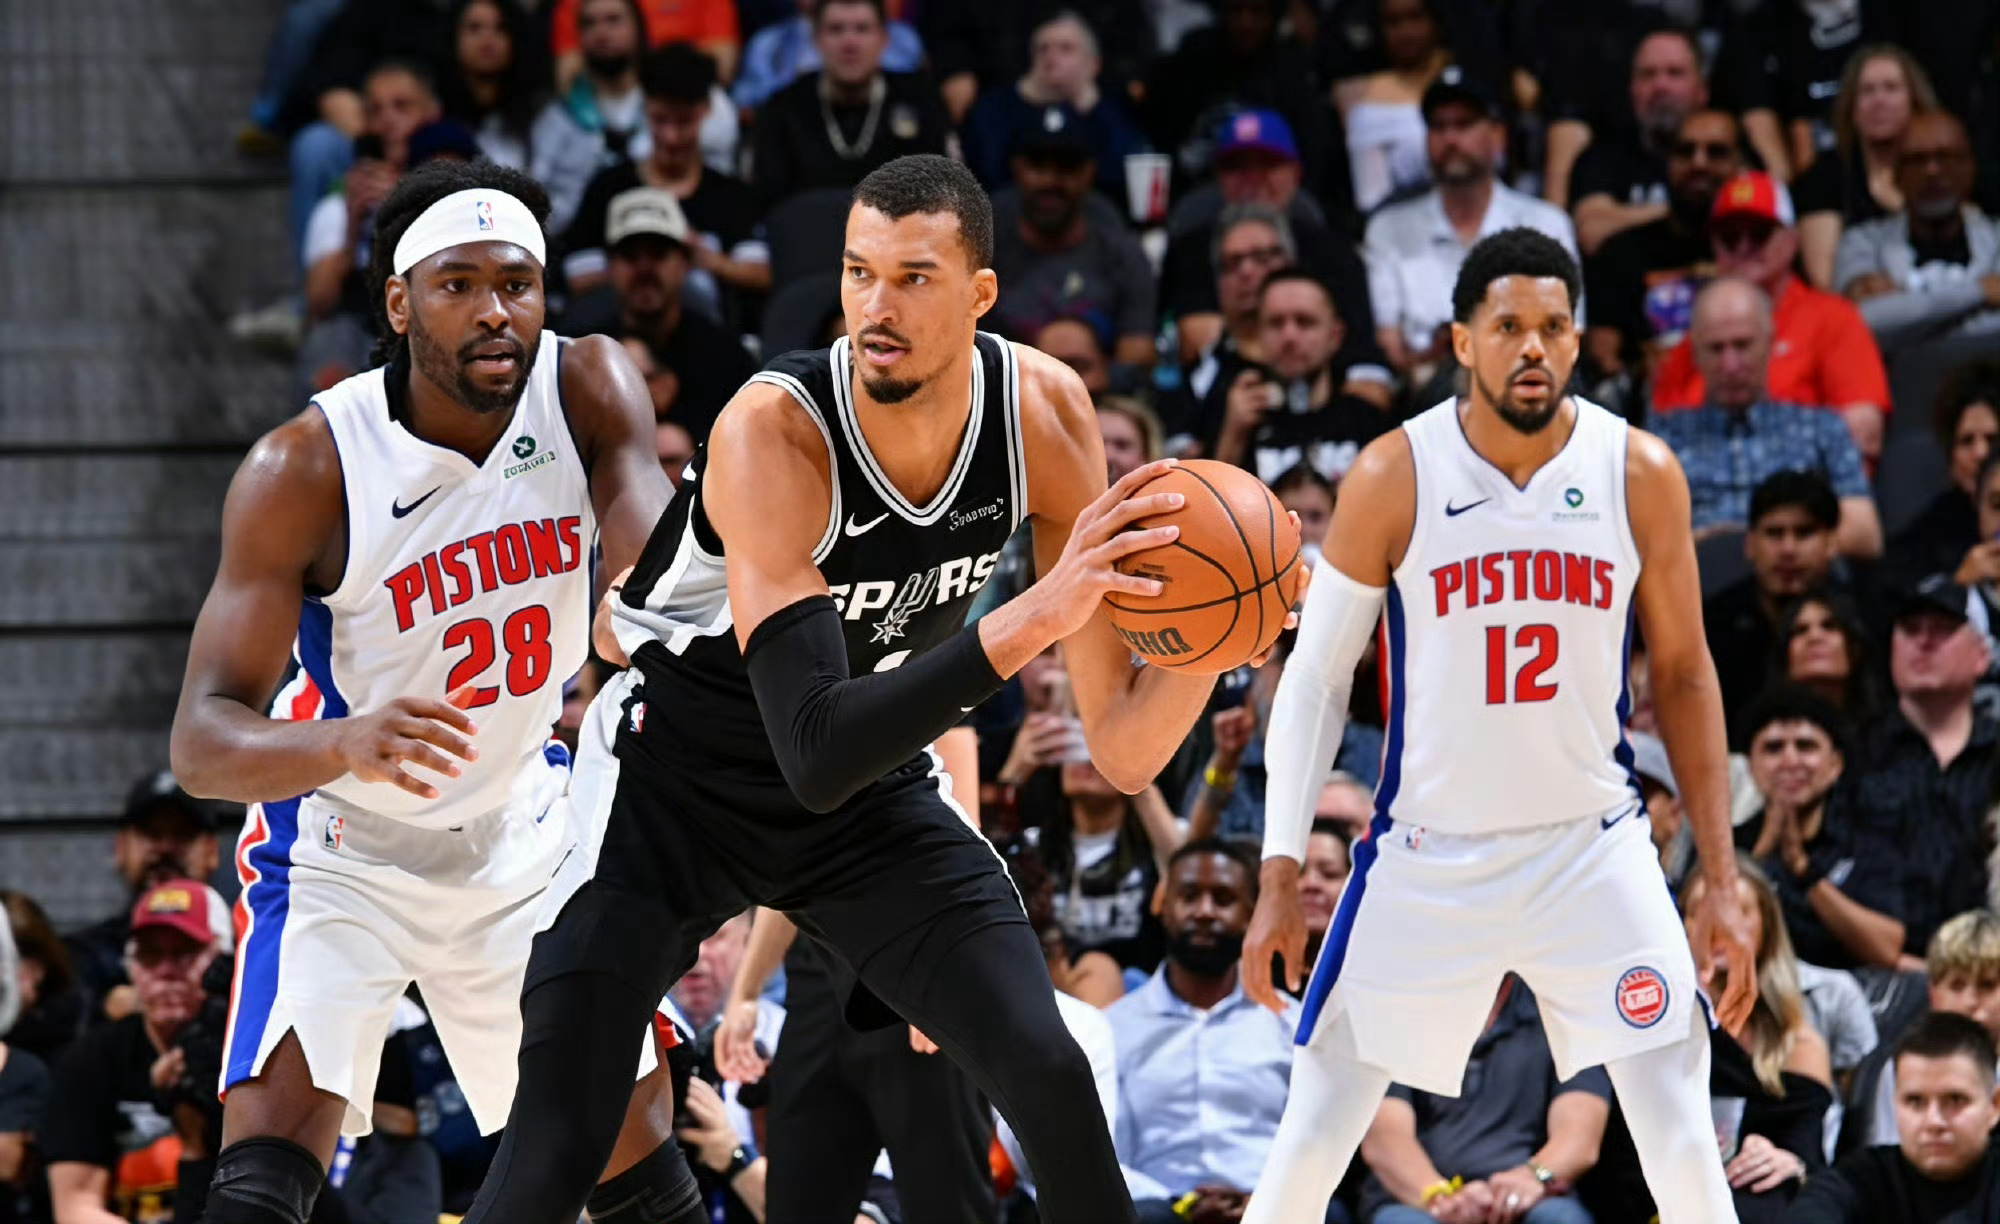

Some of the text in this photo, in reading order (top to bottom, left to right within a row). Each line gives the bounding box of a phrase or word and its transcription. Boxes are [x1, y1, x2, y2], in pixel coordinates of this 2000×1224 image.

[384, 516, 580, 633] PISTONS
[1429, 549, 1614, 618] PISTONS
[443, 604, 552, 710] 28
[1485, 623, 1559, 705] 12
